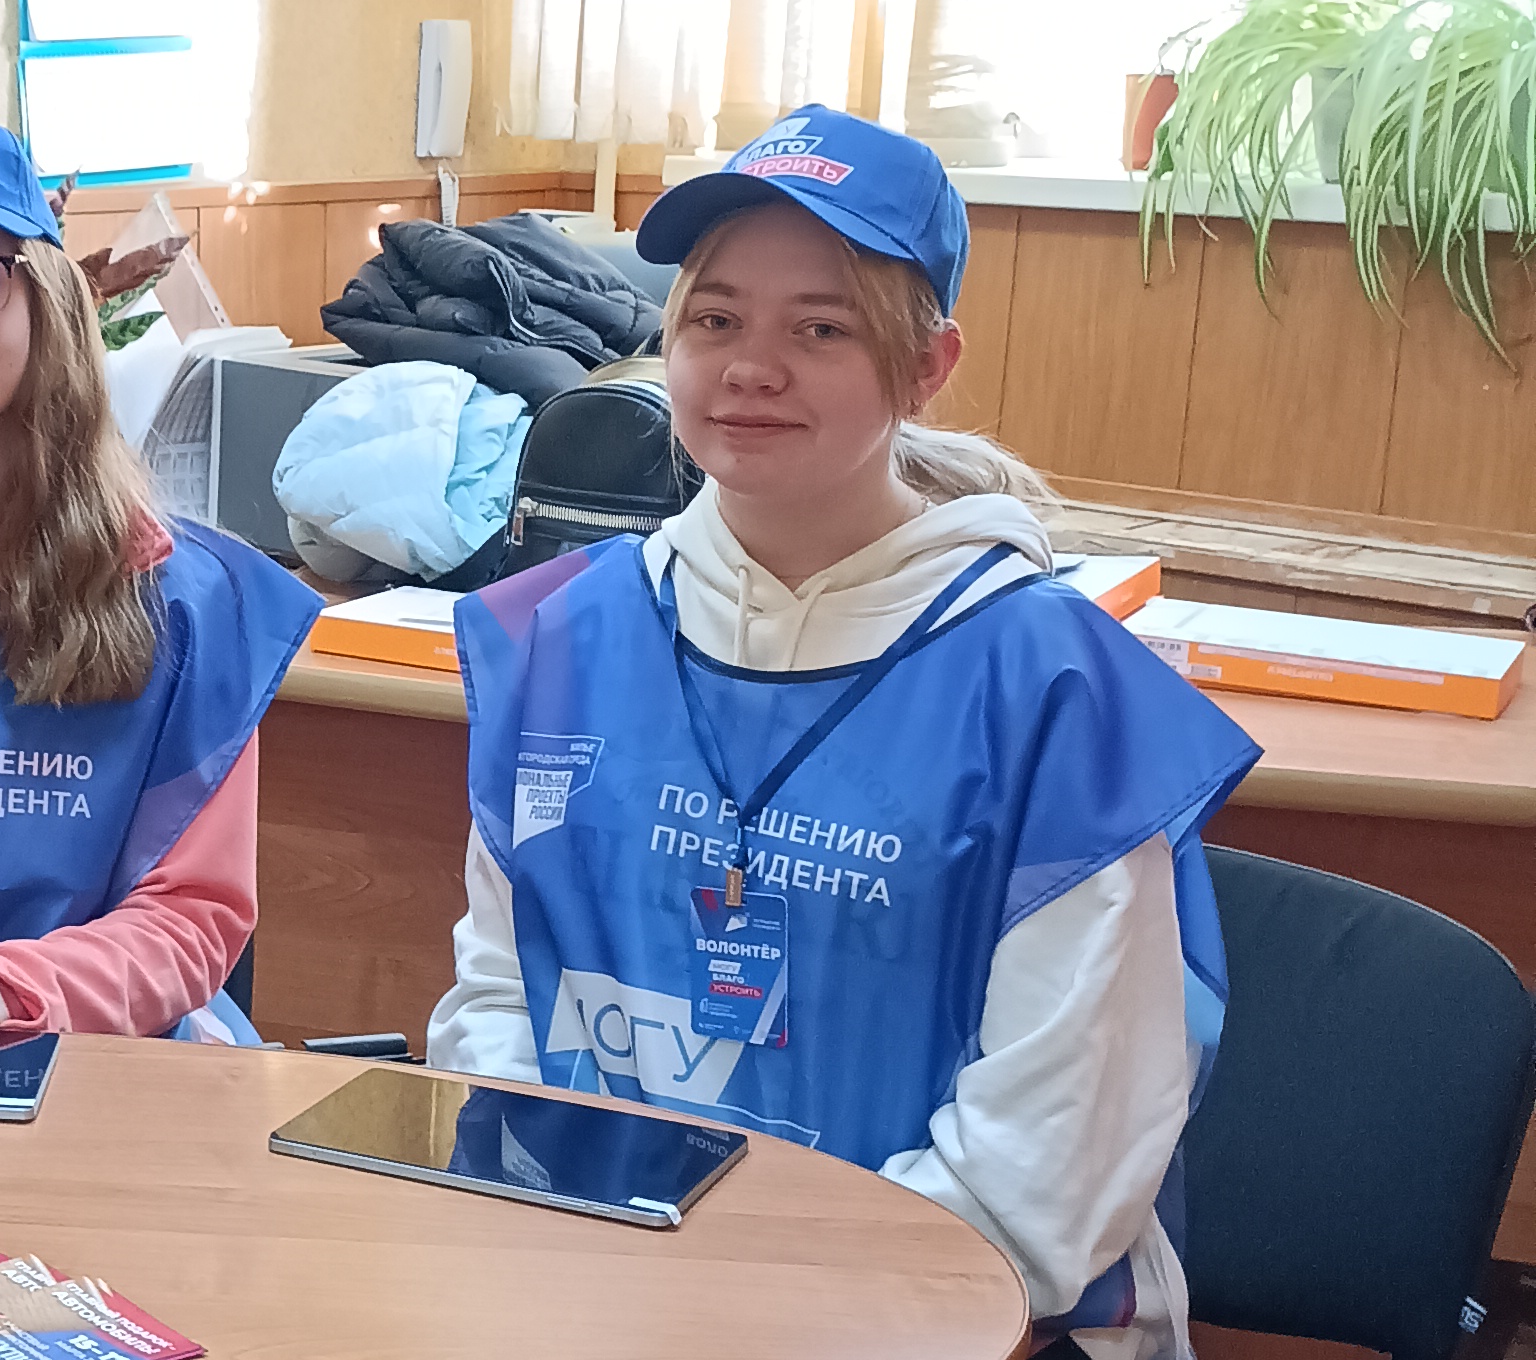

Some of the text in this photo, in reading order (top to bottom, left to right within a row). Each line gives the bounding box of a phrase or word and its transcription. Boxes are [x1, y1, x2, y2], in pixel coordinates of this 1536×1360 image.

[744, 140, 807, 161] ЛАГО
[744, 159, 838, 180] СТРОИТЬ
[658, 783, 901, 863] ПО РШЕНИЮ
[696, 938, 781, 961] ВОЛОНТЁР
